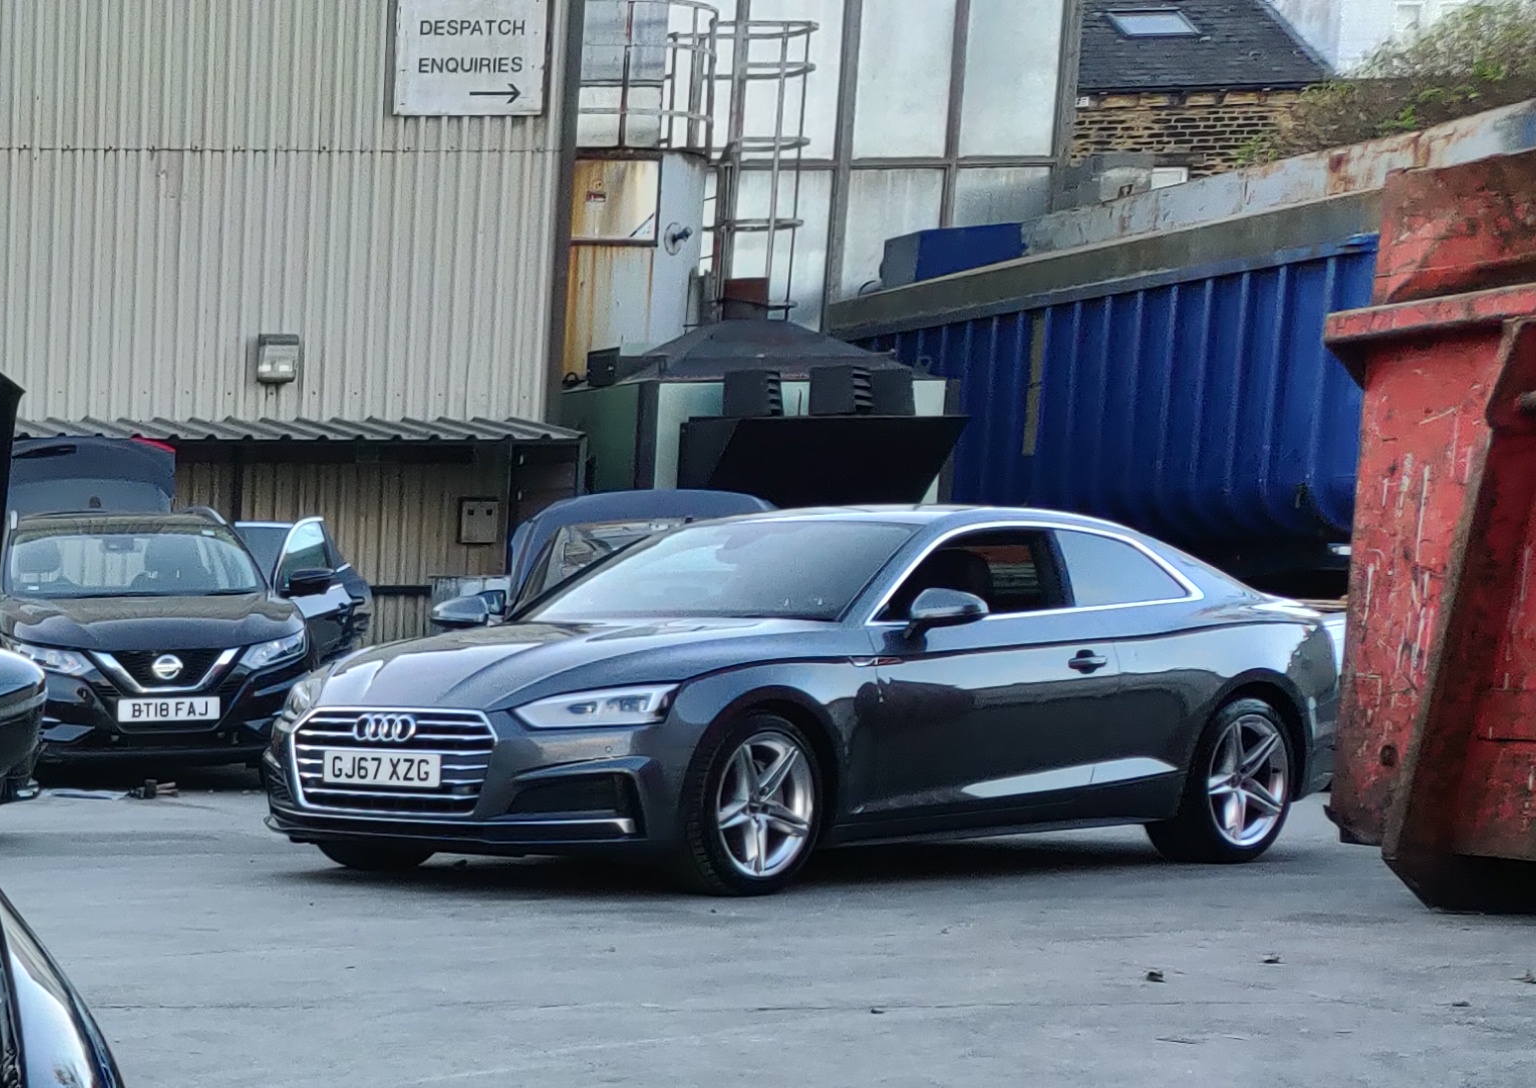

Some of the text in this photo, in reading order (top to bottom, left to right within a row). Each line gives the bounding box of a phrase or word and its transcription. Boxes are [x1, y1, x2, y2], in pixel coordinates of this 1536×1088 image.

[419, 19, 526, 36] DESPATCH
[418, 56, 524, 74] ENQUIRIES
[131, 700, 209, 719] BT18 FAJ
[331, 755, 430, 782] GJ67 XZG
